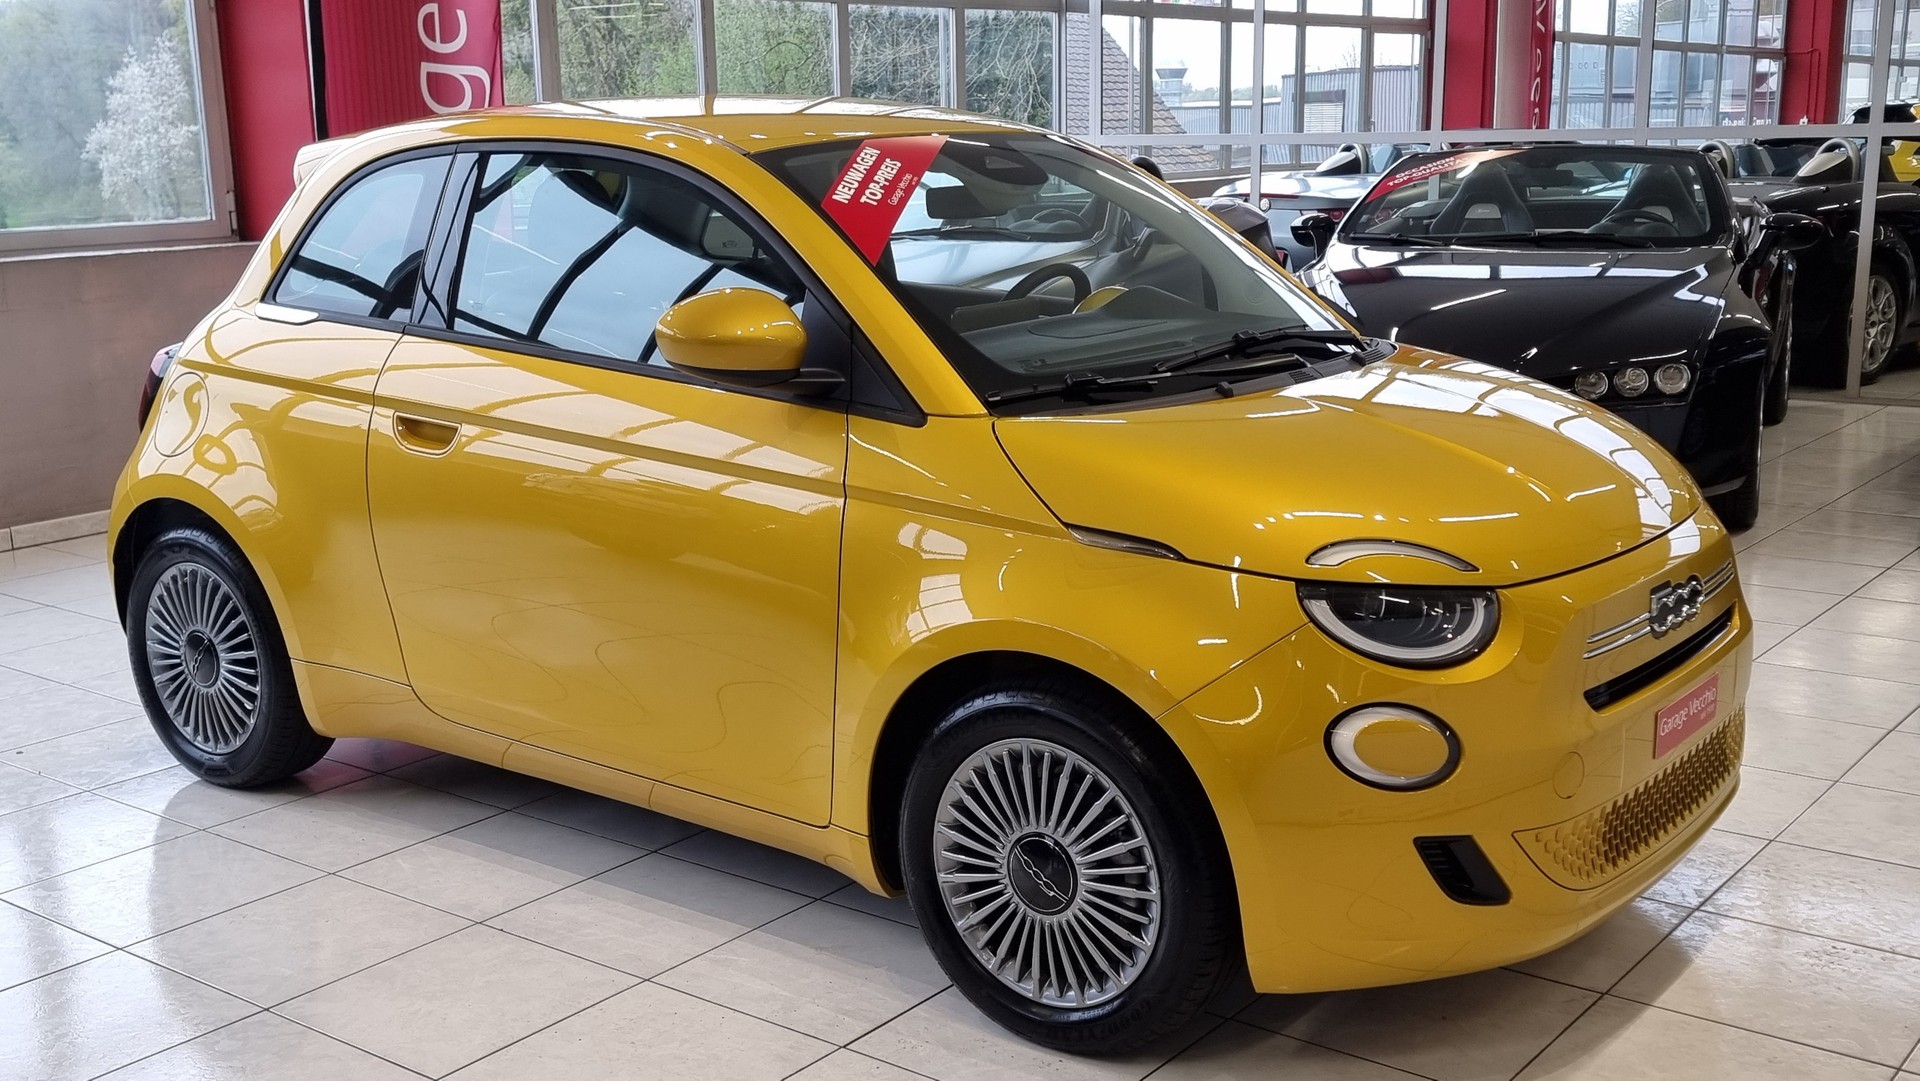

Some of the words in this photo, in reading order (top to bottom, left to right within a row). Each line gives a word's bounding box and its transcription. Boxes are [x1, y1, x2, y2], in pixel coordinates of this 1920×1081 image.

[417, 3, 491, 114] ge
[832, 146, 881, 204] NEUWAGEN
[860, 158, 902, 206] TOP-PREIS
[887, 188, 905, 206] Garage
[896, 173, 913, 190] Vecchio
[1395, 157, 1455, 179] OCCASION
[1660, 707, 1689, 737] Garage
[1690, 686, 1717, 716] Vecchio
